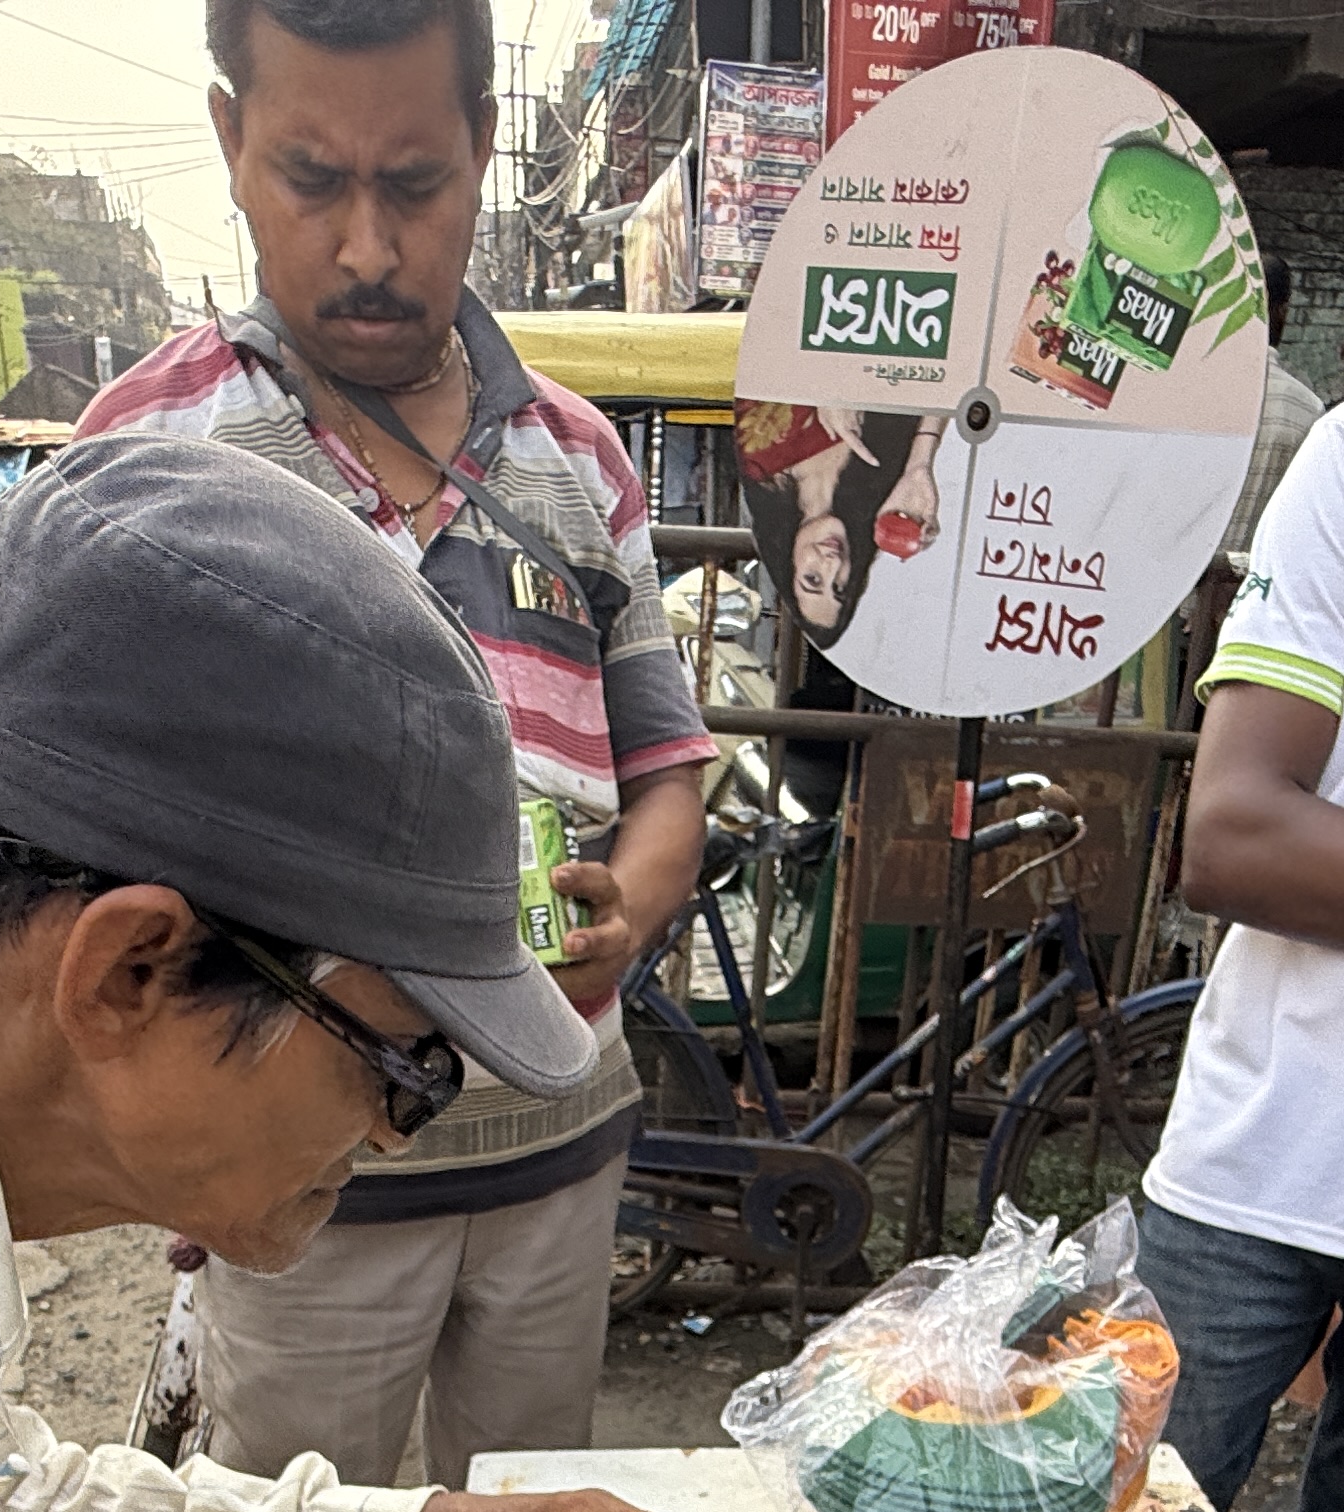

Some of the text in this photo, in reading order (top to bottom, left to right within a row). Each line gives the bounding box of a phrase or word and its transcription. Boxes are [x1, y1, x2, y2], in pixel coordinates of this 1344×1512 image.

[872, 5, 920, 43] 20%
[975, 12, 1018, 48] 75%
[820, 176, 969, 205] কোকাম সাবান
[824, 221, 961, 261] নিম সাবান ও
[808, 273, 950, 347] খাস
[1117, 285, 1175, 346] Khas
[986, 479, 1053, 526] চান
[976, 537, 1106, 591] চনমনে
[985, 594, 1105, 661] খাস
